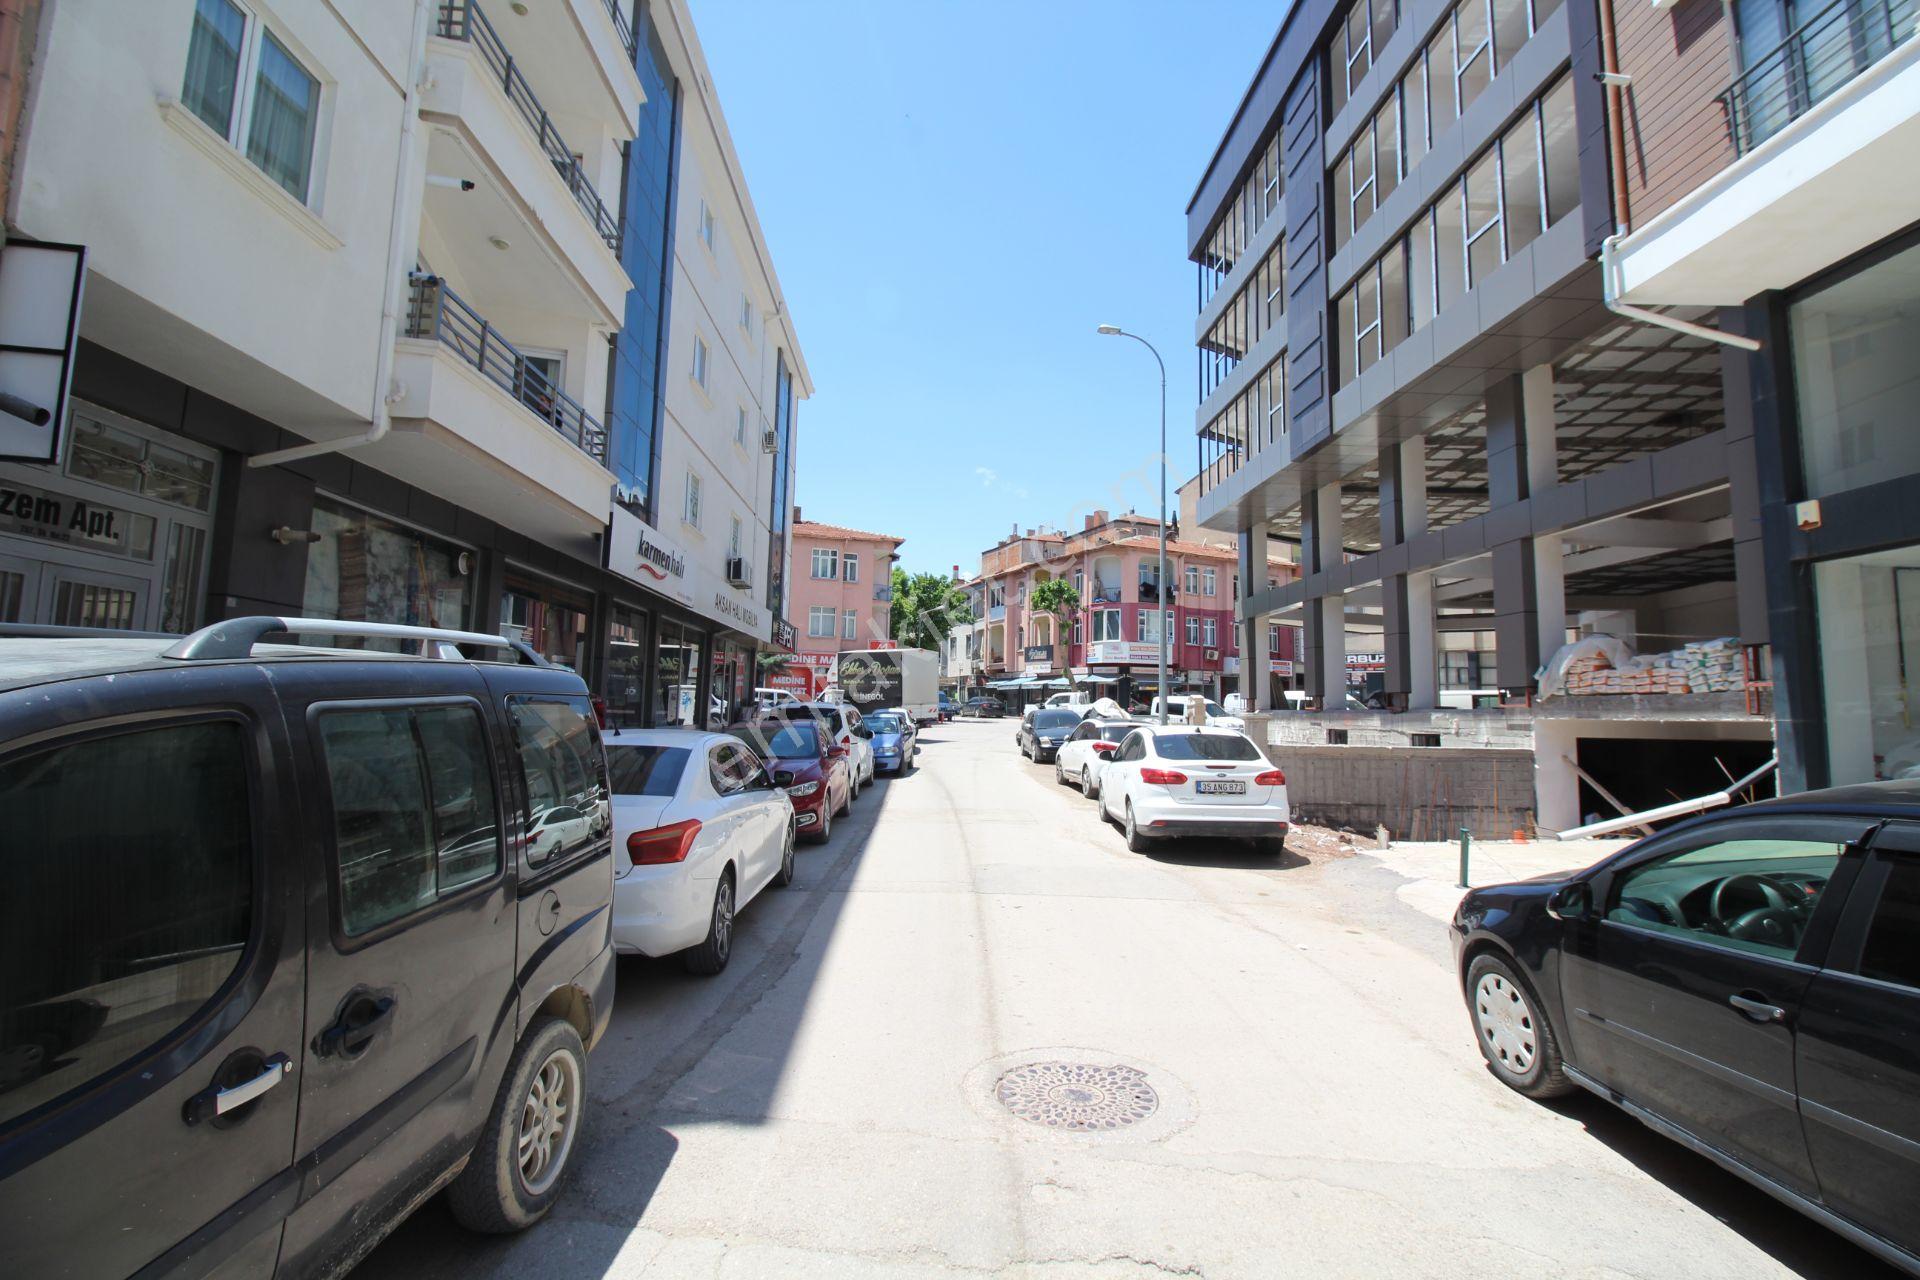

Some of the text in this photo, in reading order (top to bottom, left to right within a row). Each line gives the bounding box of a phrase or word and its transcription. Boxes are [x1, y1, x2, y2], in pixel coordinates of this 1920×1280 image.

[69, 501, 119, 539] Apt.
[638, 530, 671, 571] karmen
[772, 675, 806, 685] MEDİNE
[1202, 783, 1212, 791] 35
[1213, 783, 1228, 791] ANG
